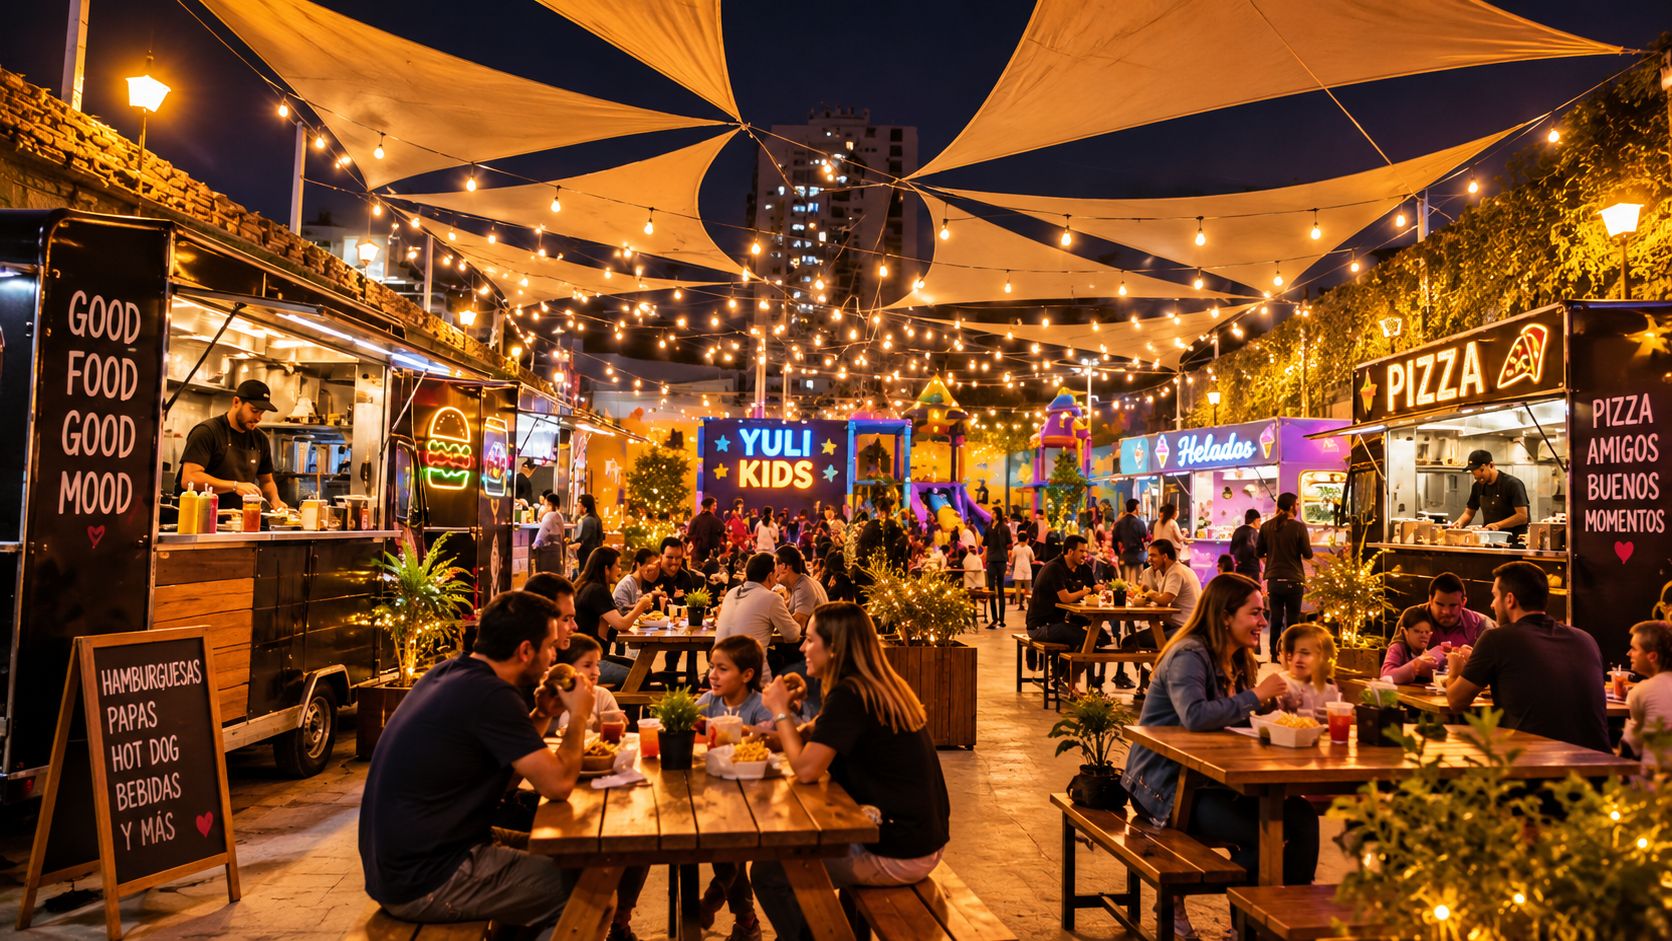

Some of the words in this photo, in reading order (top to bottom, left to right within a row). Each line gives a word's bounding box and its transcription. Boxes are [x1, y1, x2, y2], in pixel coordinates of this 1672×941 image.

[68, 290, 142, 344] GOOD
[66, 350, 138, 401] FOOD
[1386, 341, 1485, 412] PIZZA
[1592, 393, 1654, 428] PIZZA
[61, 409, 136, 458] GOOD
[739, 428, 811, 457] YULI
[1177, 432, 1257, 467] Helados
[1586, 433, 1659, 465] AMIGOS
[58, 470, 133, 515] MOOD
[739, 459, 813, 489] KIDS
[1587, 472, 1660, 501] BUENOS
[1584, 508, 1665, 534] MOMENTOS
[101, 658, 202, 696] HAMBURGUESAS
[107, 700, 158, 735] PAPAS
[111, 740, 143, 772] HOT
[149, 734, 179, 766] DOG
[116, 772, 181, 812] BEBIDAS
[120, 822, 133, 851] Y
[140, 810, 176, 847] MÁS
